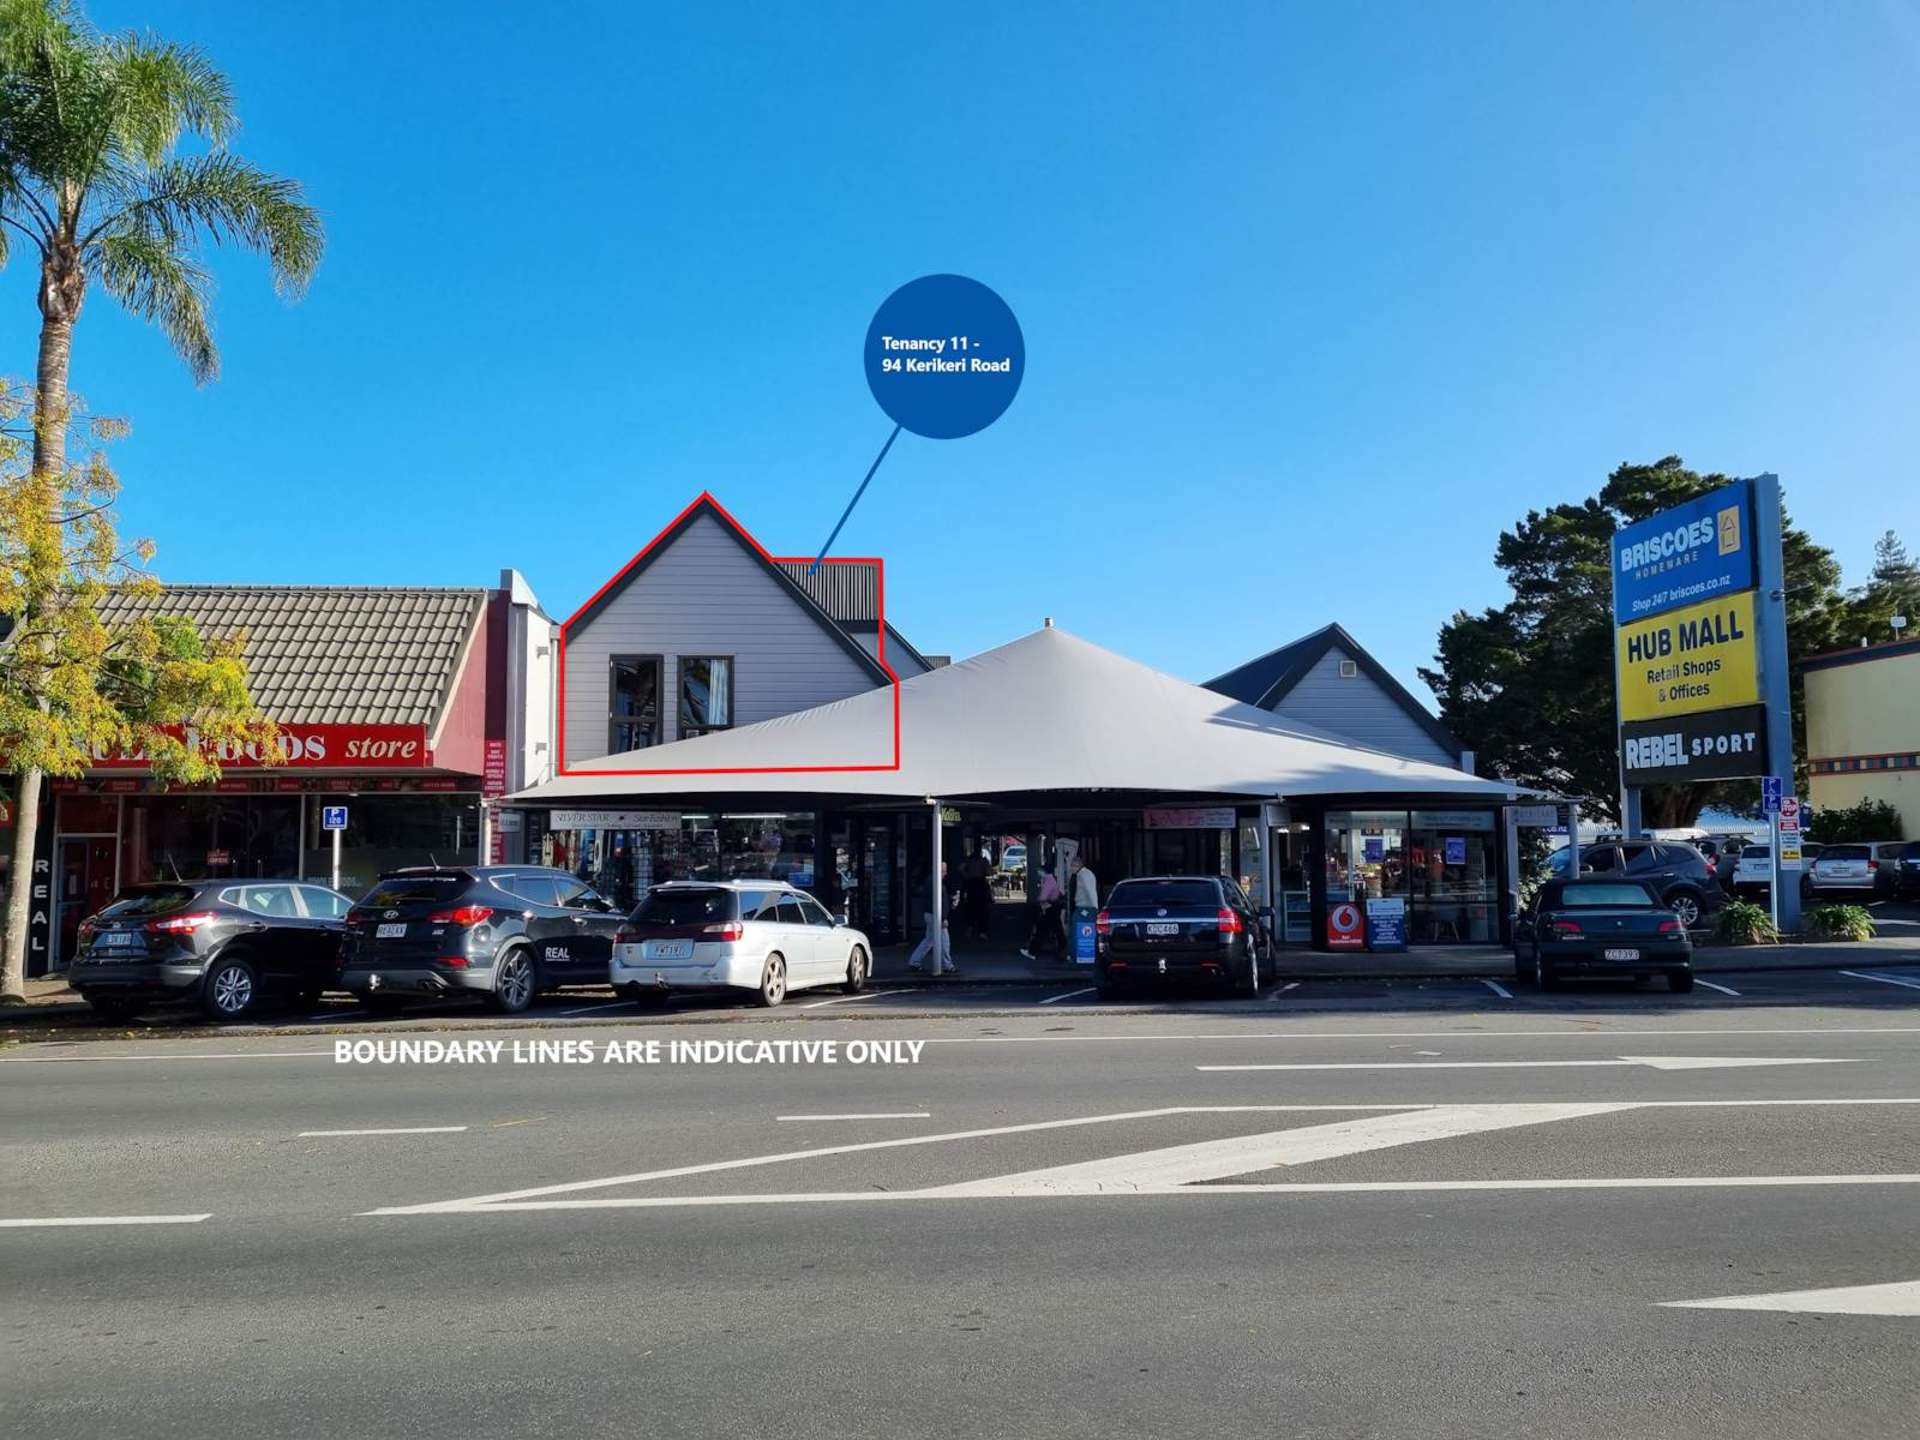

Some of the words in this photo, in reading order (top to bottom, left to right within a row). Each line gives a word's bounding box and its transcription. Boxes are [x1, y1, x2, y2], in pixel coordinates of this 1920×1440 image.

[1621, 517, 1714, 572] BRISCOES
[1635, 551, 1698, 580] HOMEWARE
[1632, 599, 1652, 612] Shop
[1669, 575, 1731, 601] briscoes.co.nz
[1627, 628, 1672, 663] HUB
[1679, 610, 1744, 652] MALL
[1647, 664, 1680, 683] Retail
[1682, 659, 1721, 676] Shops
[1669, 683, 1710, 701] Offices
[345, 737, 418, 759] store
[1625, 733, 1689, 769] REBEL
[1691, 732, 1756, 757] SPORT
[32, 859, 49, 951] REAL
[545, 947, 570, 959] REAL
